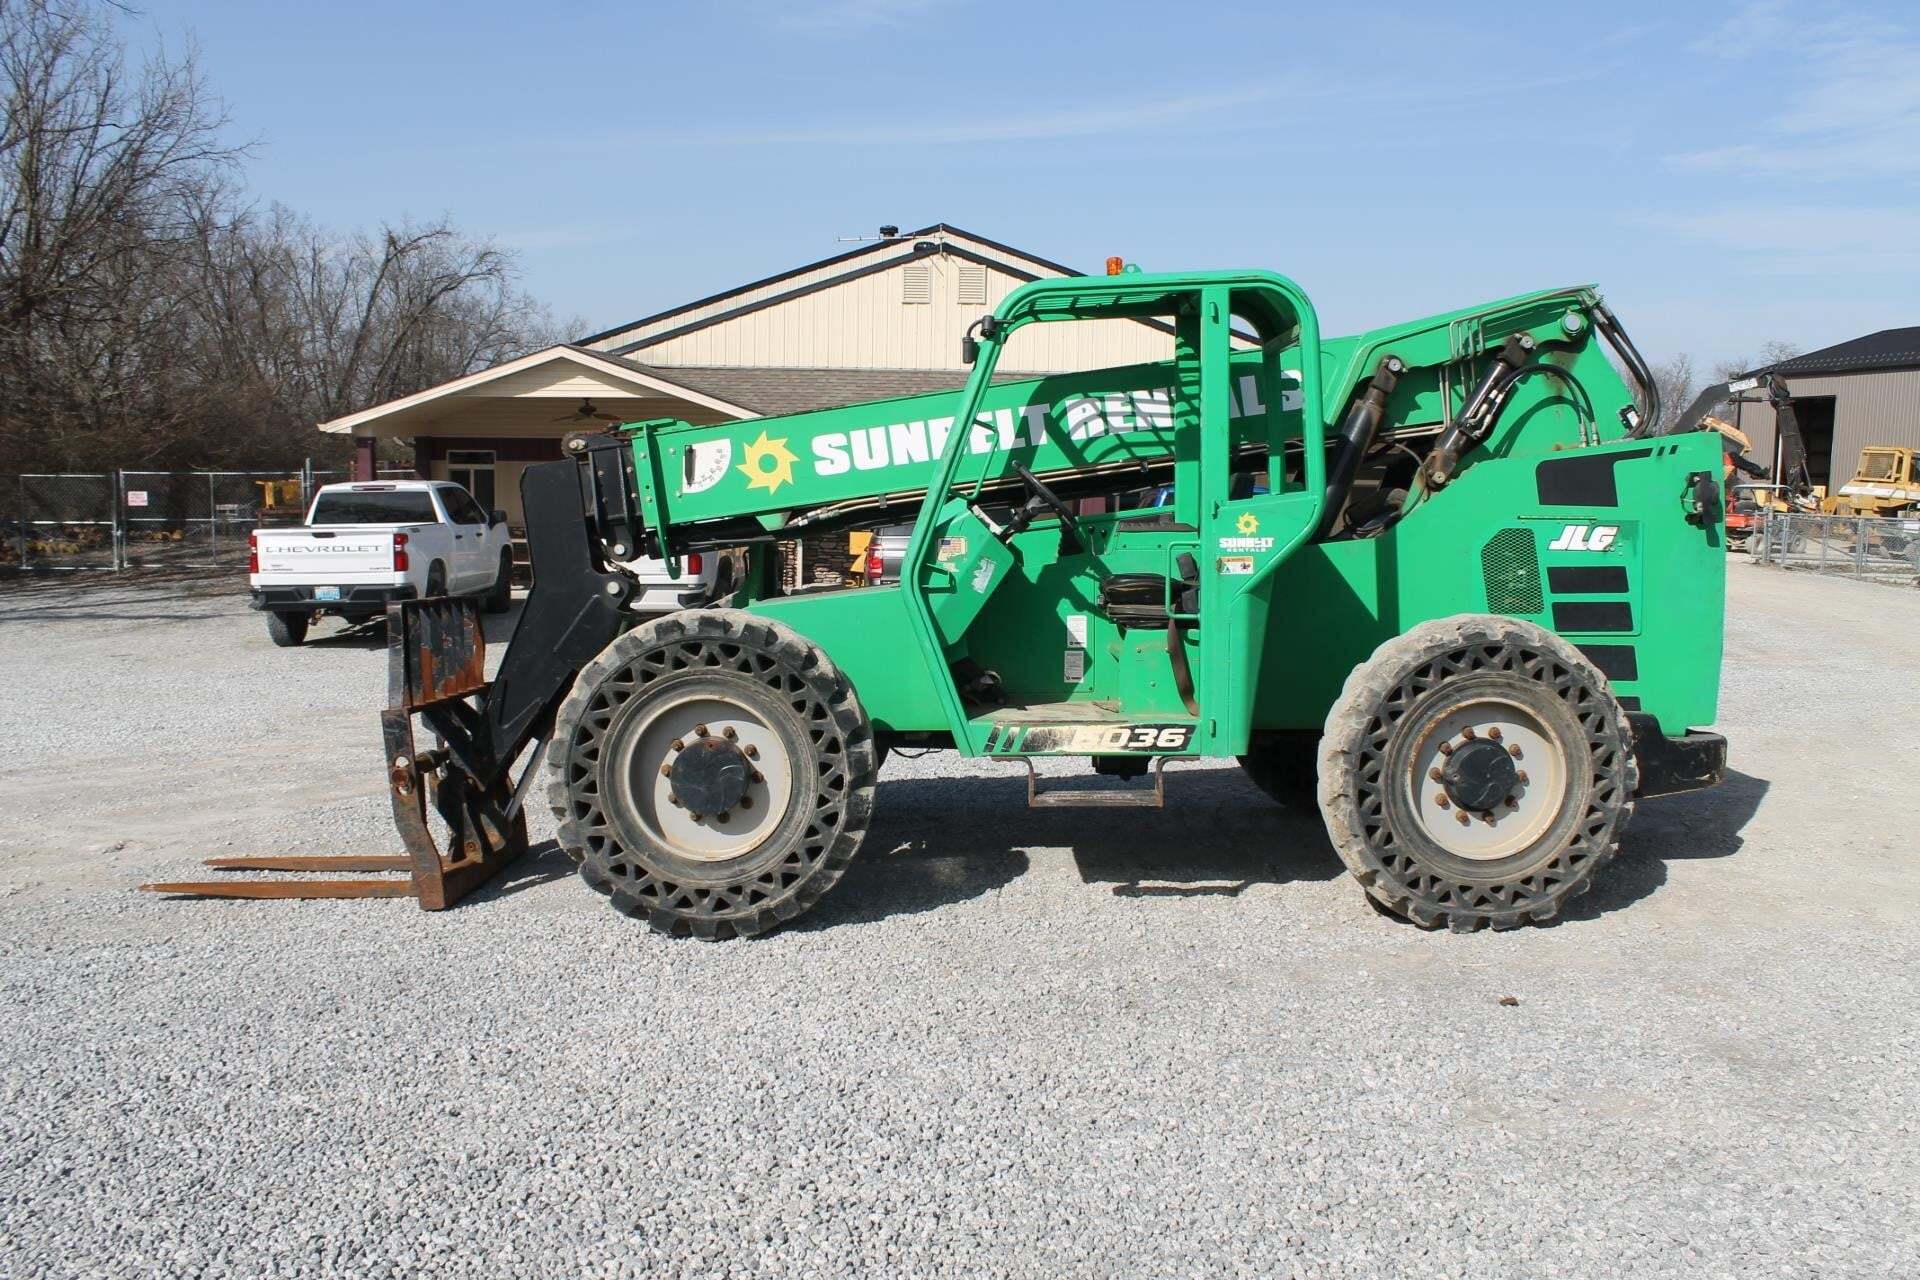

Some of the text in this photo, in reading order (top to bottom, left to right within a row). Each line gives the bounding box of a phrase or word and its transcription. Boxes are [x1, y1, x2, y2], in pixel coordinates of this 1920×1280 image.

[1065, 369, 1304, 441] RENLS
[266, 545, 382, 553] CHEVROLET
[1548, 525, 1619, 551] JLG
